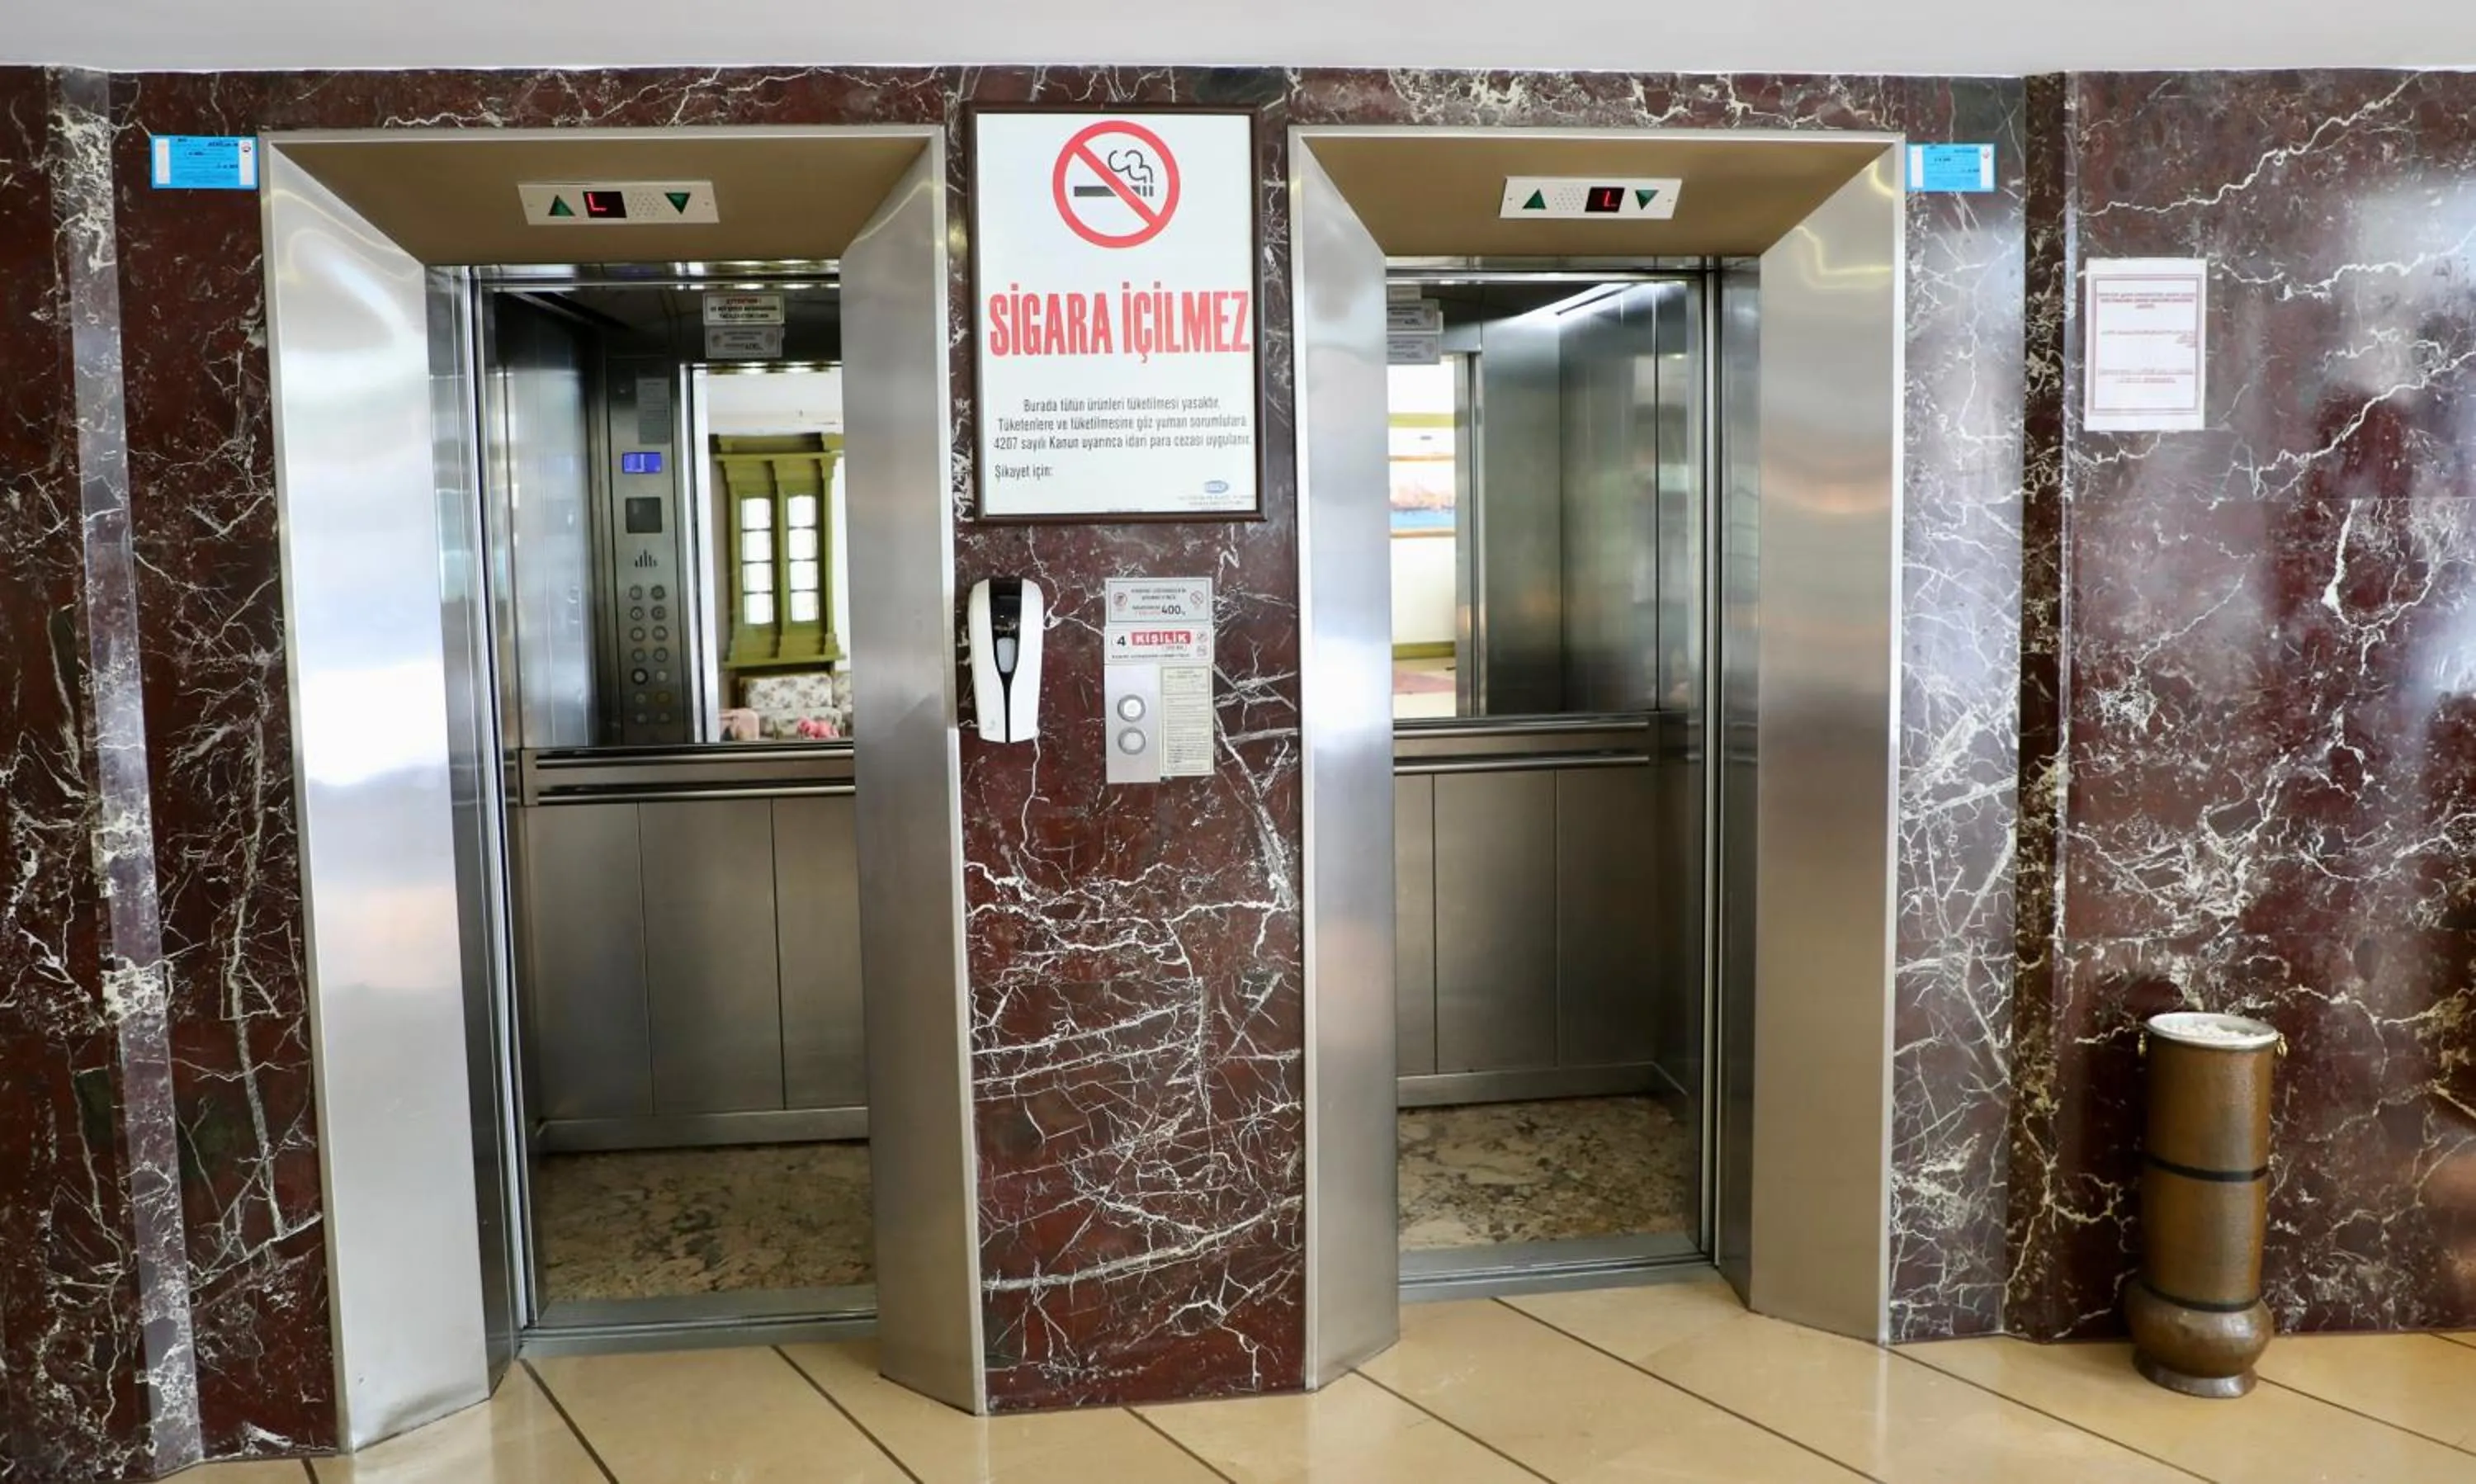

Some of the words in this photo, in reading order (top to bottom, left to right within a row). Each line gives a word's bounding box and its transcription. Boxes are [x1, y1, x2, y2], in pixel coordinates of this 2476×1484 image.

[588, 192, 607, 211] L
[1604, 191, 1617, 207] L
[990, 282, 1113, 357] SİGARA
[1122, 281, 1250, 363] İÇİLMEZ
[1023, 399, 1057, 412] Burada
[1061, 398, 1084, 411] tütün
[1087, 397, 1124, 411] ürünleri
[1127, 396, 1179, 410] tüketilmesi
[998, 418, 1054, 432] Tüketenlere
[1056, 419, 1068, 430] ve
[1070, 416, 1133, 430] tüketilmesine
[1136, 416, 1153, 432] göz
[1155, 416, 1188, 431] yuman
[993, 437, 1018, 450] 4207
[1049, 436, 1079, 450] Kanun
[1082, 437, 1123, 451] uyarınca
[1126, 433, 1146, 448] idari
[1150, 435, 1171, 449] para
[995, 464, 1030, 481] Şikayet
[1032, 463, 1054, 480] için:
[1161, 605, 1181, 615] 400
[1117, 636, 1127, 646] 4
